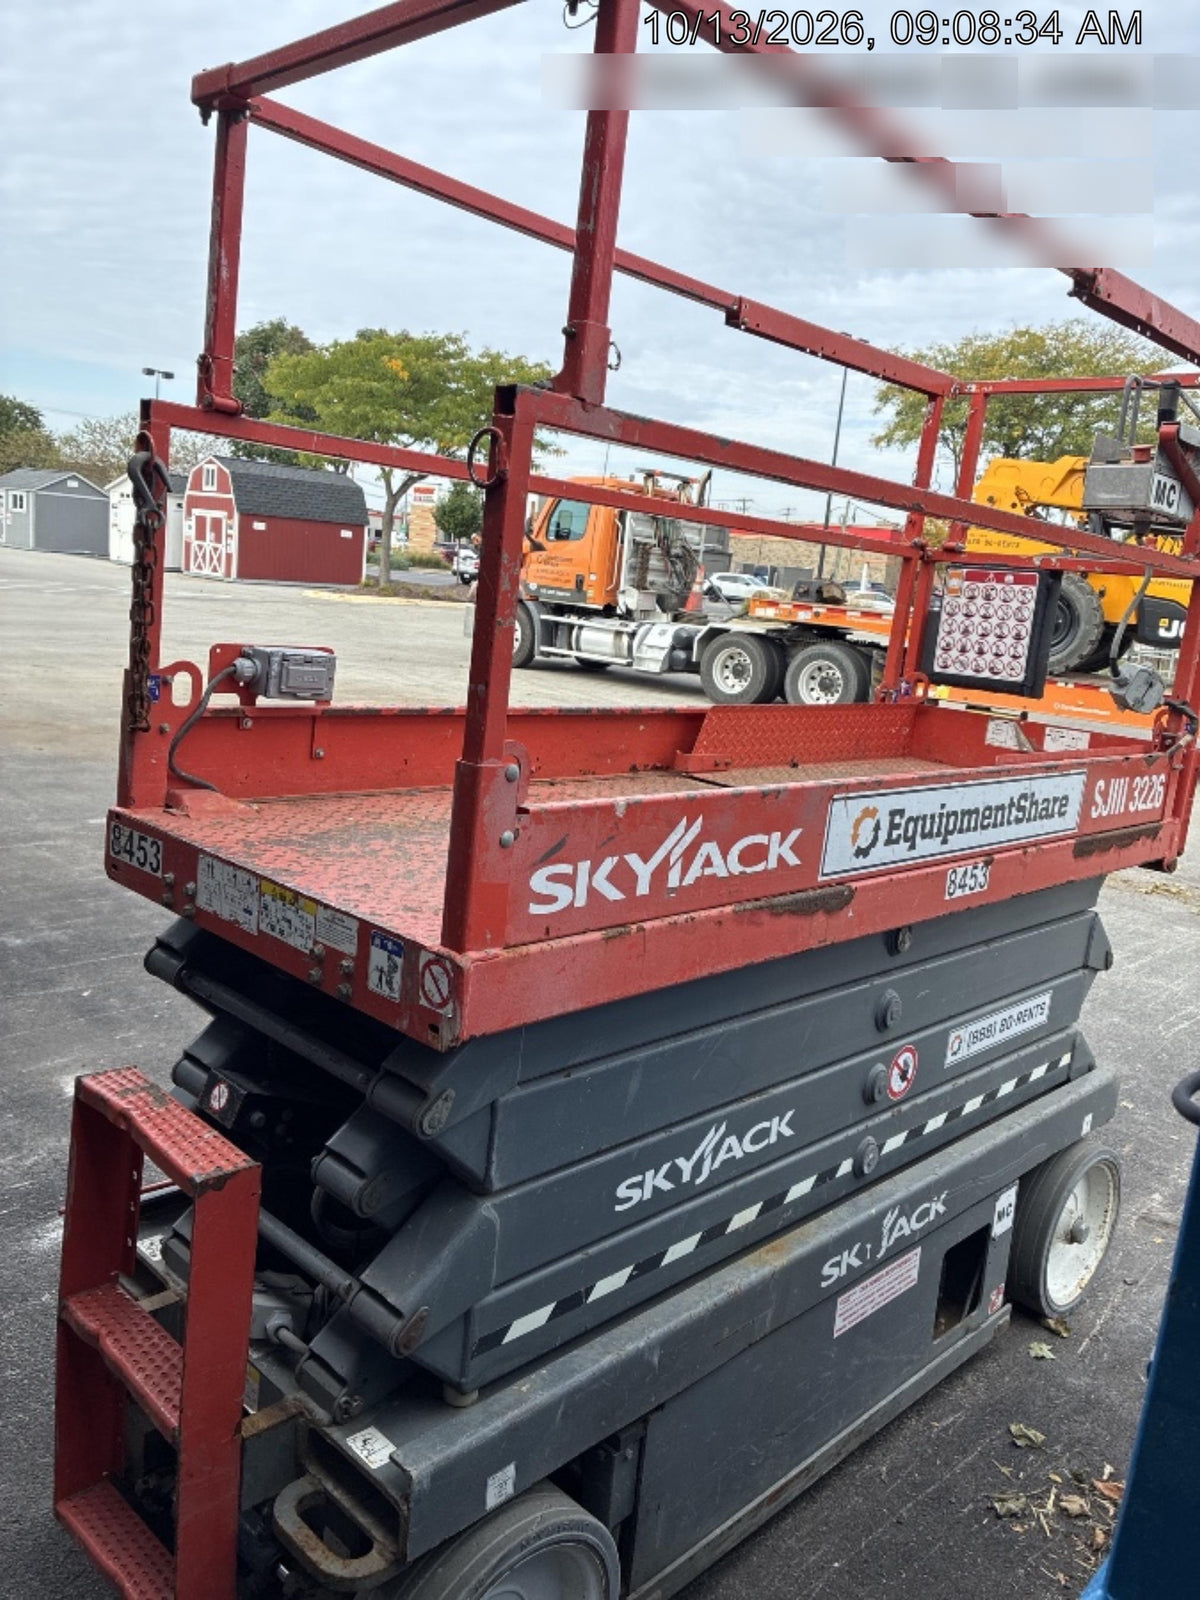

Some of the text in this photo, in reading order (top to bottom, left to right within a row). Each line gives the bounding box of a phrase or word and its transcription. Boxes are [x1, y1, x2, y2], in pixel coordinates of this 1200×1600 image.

[1154, 479, 1177, 508] MC
[1129, 773, 1166, 813] 3226
[884, 791, 1070, 851] EquipmentShare
[111, 824, 161, 874] 8453
[947, 865, 988, 897] 8453
[614, 1109, 796, 1212] SKYJACK
